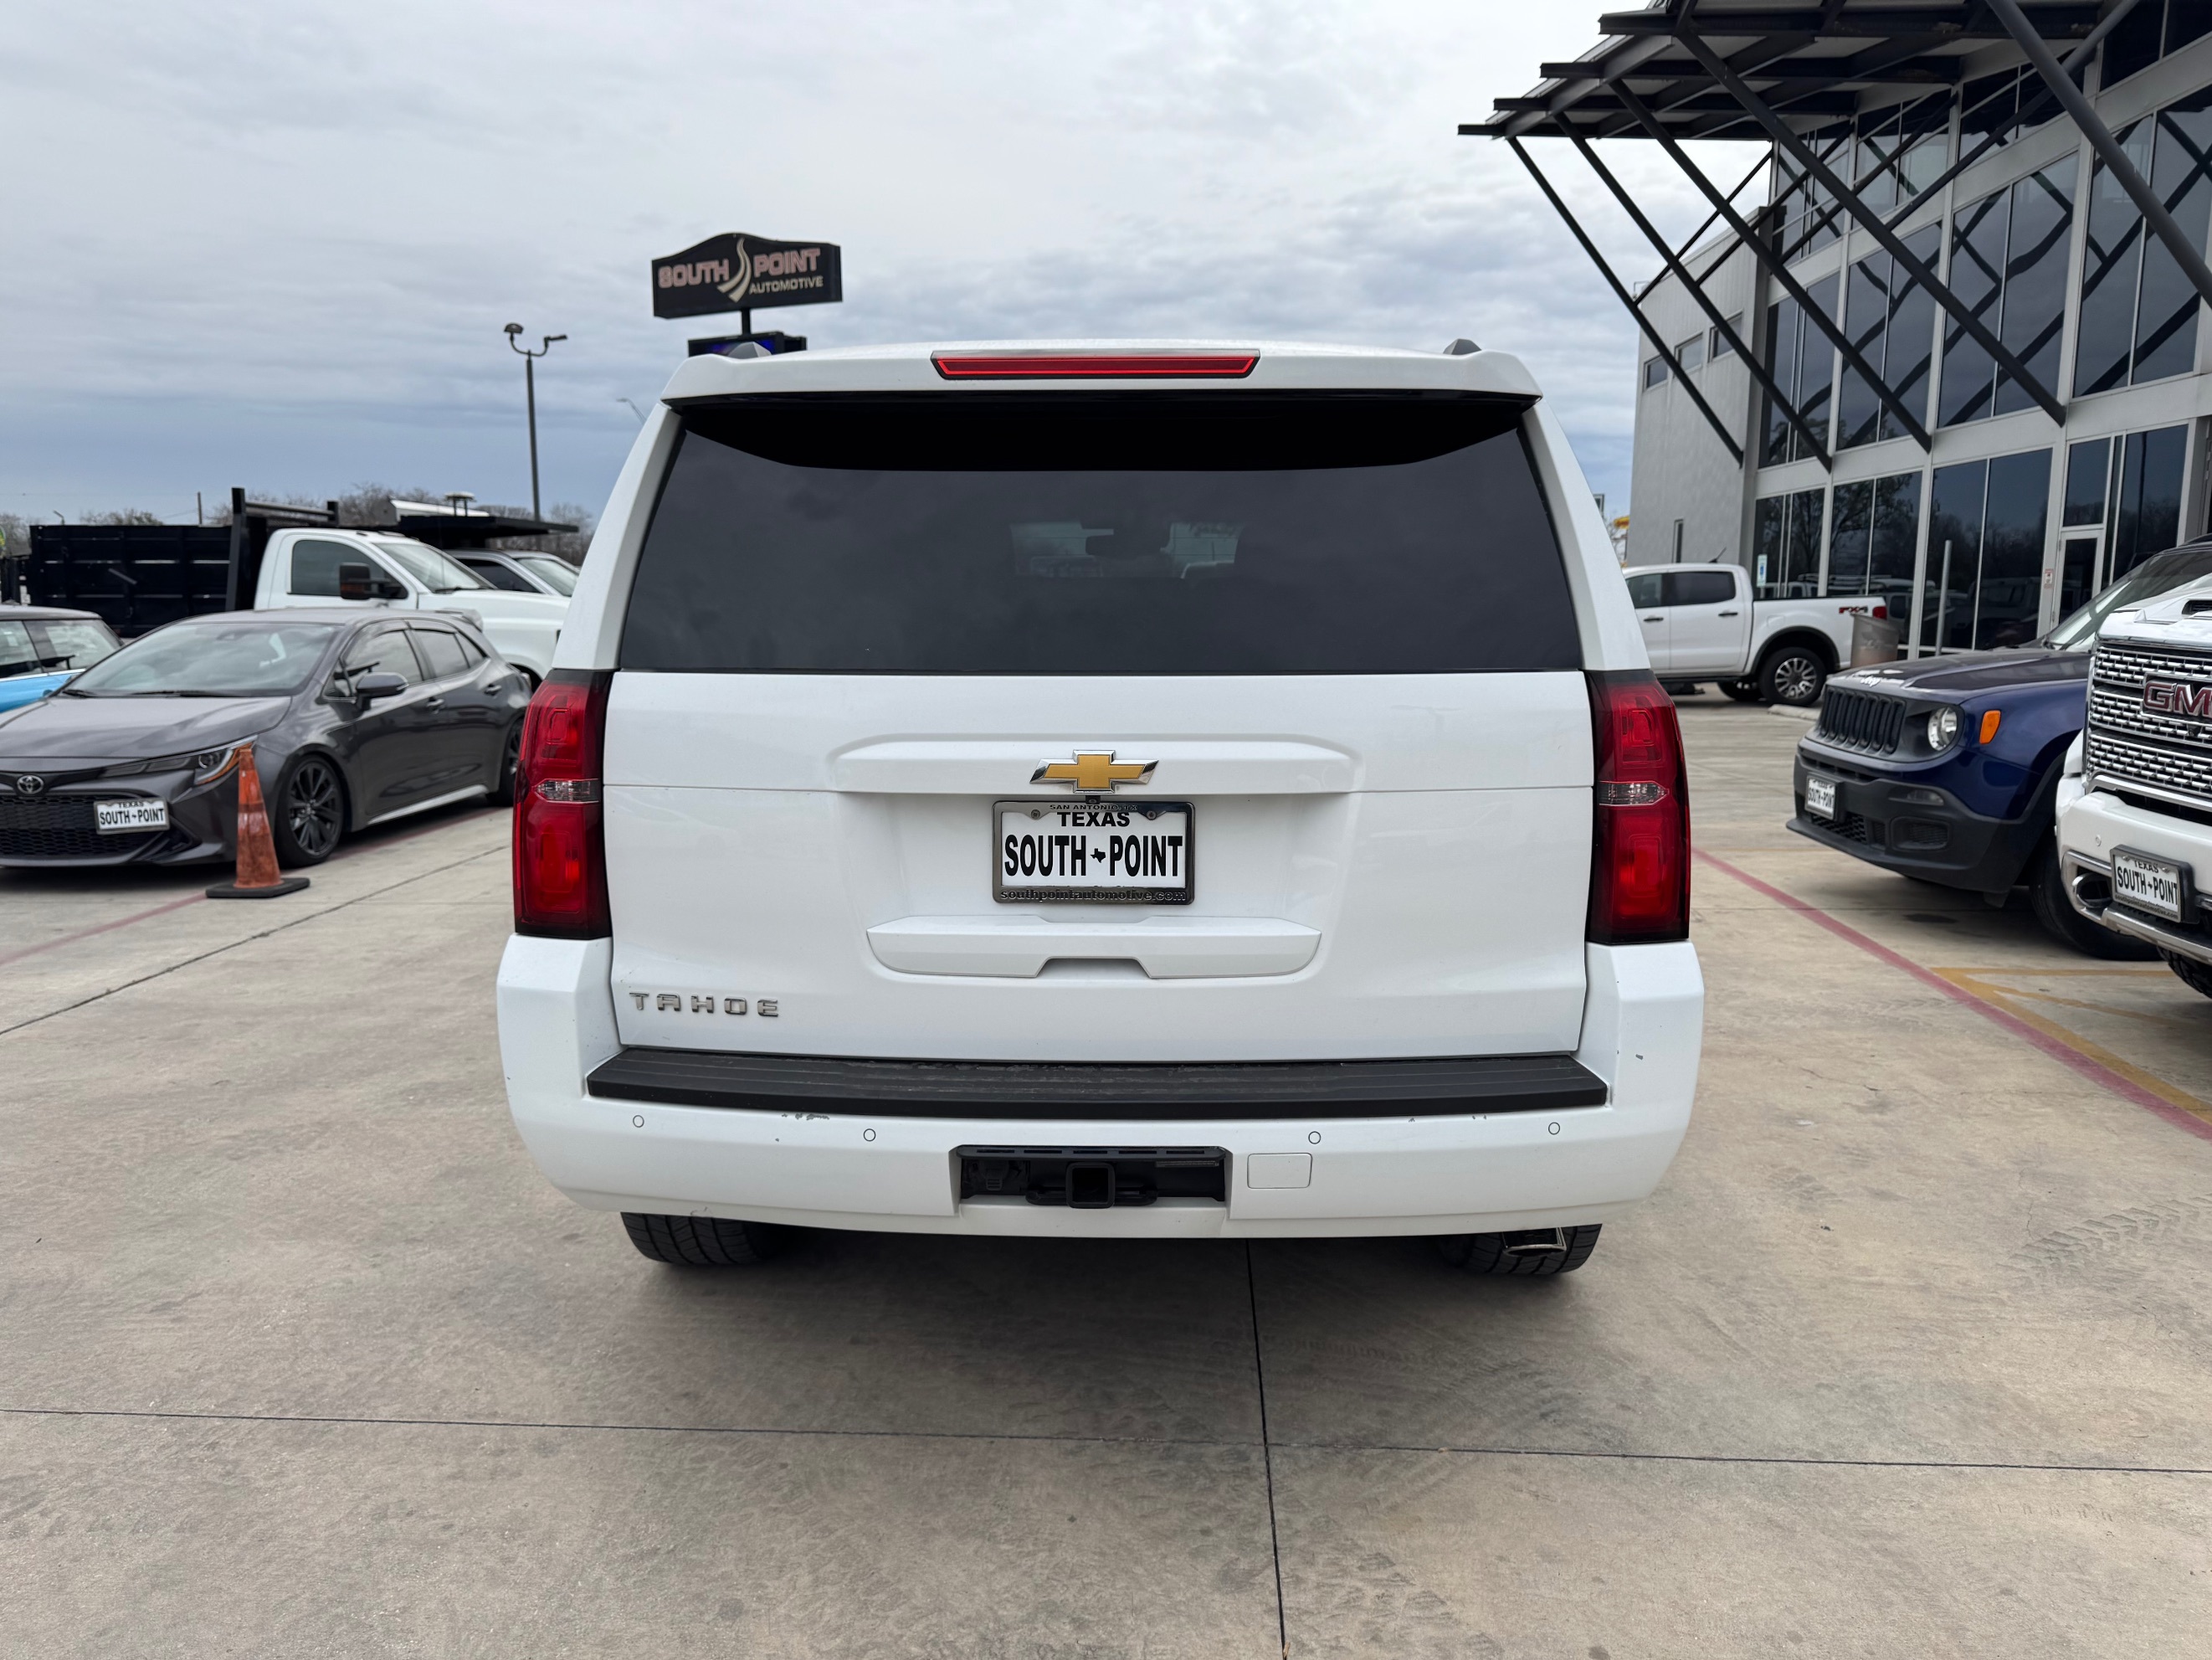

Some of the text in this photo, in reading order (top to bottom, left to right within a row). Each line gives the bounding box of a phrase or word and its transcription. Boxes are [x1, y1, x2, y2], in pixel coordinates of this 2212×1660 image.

[658, 248, 821, 289] SOUTH POINT
[749, 275, 824, 294] AUTOMOTIVE
[2144, 680, 2212, 718] GM
[100, 808, 163, 825] SOUTH POINT
[1057, 812, 1131, 827] TEXAS
[1004, 835, 1183, 877] SOUTH POINT
[2134, 860, 2159, 873] TEXAS
[1000, 889, 1187, 902] southpointautomotive.com
[2117, 866, 2147, 895] SOUTH
[2153, 876, 2178, 906] POINT
[629, 992, 779, 1017] TAHOE
